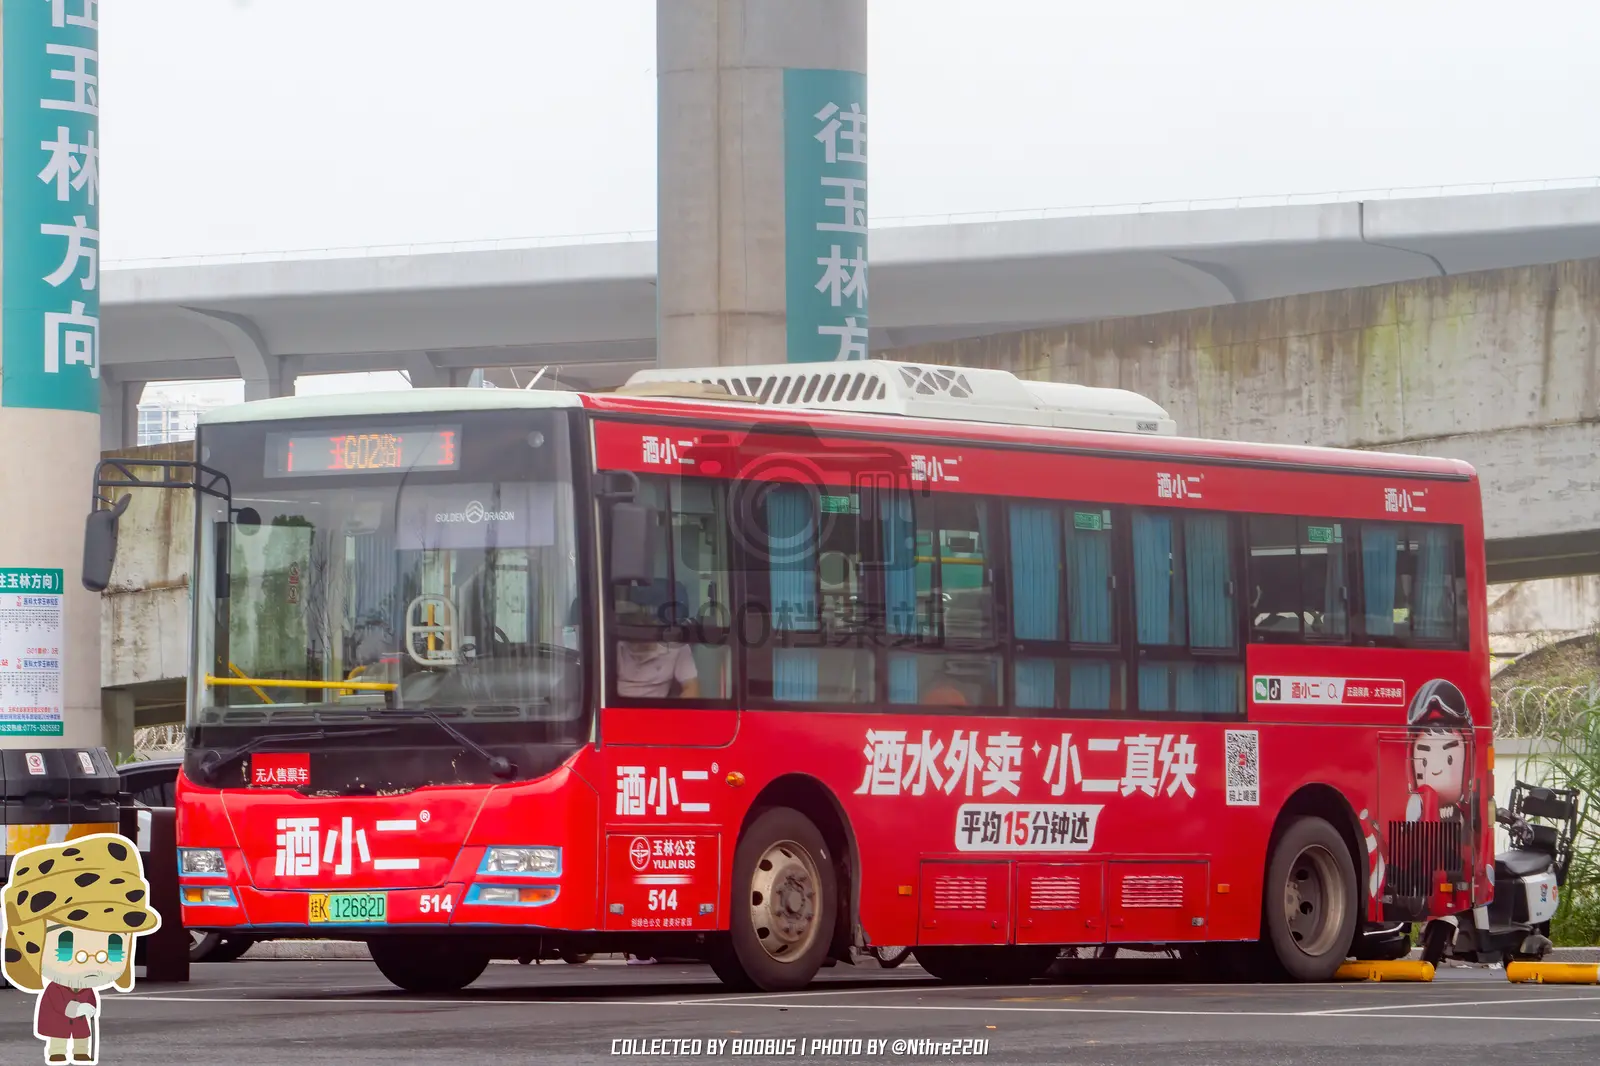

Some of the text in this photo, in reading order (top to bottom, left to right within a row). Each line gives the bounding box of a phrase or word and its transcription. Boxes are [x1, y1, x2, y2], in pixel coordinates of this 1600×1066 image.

[642, 435, 695, 465] 酒小二
[1156, 472, 1202, 499] 酒小二
[1384, 488, 1427, 512] 酒小二
[435, 511, 515, 523] GOLDEN DRAGON
[255, 767, 309, 782] 无人售票车
[853, 728, 1198, 799] 酒水外卖 小二真快
[960, 810, 1091, 846] 平均15分钟达
[652, 839, 697, 856] 玉林公交
[652, 859, 696, 869] YULIN BUS
[420, 894, 453, 913] 514
[648, 888, 678, 911] 514
